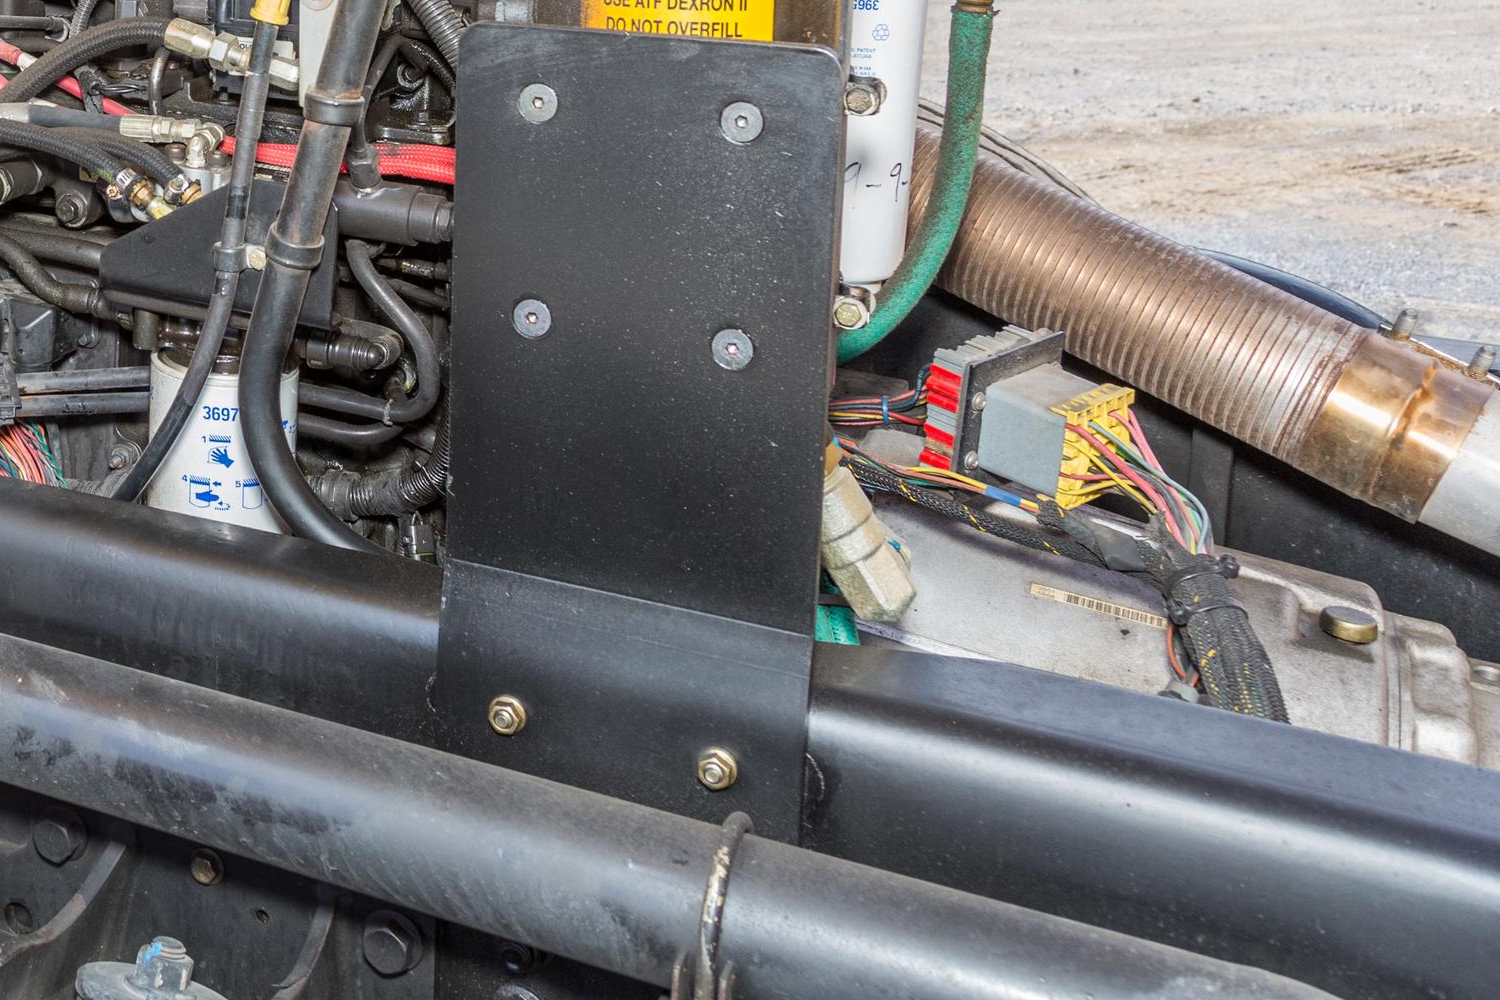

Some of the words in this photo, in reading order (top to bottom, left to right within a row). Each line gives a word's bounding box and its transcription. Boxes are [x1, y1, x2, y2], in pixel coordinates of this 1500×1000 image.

[606, 16, 626, 32] DO
[631, 18, 662, 34] NOT
[667, 20, 742, 38] OVERFILL
[203, 406, 239, 422] 3697
